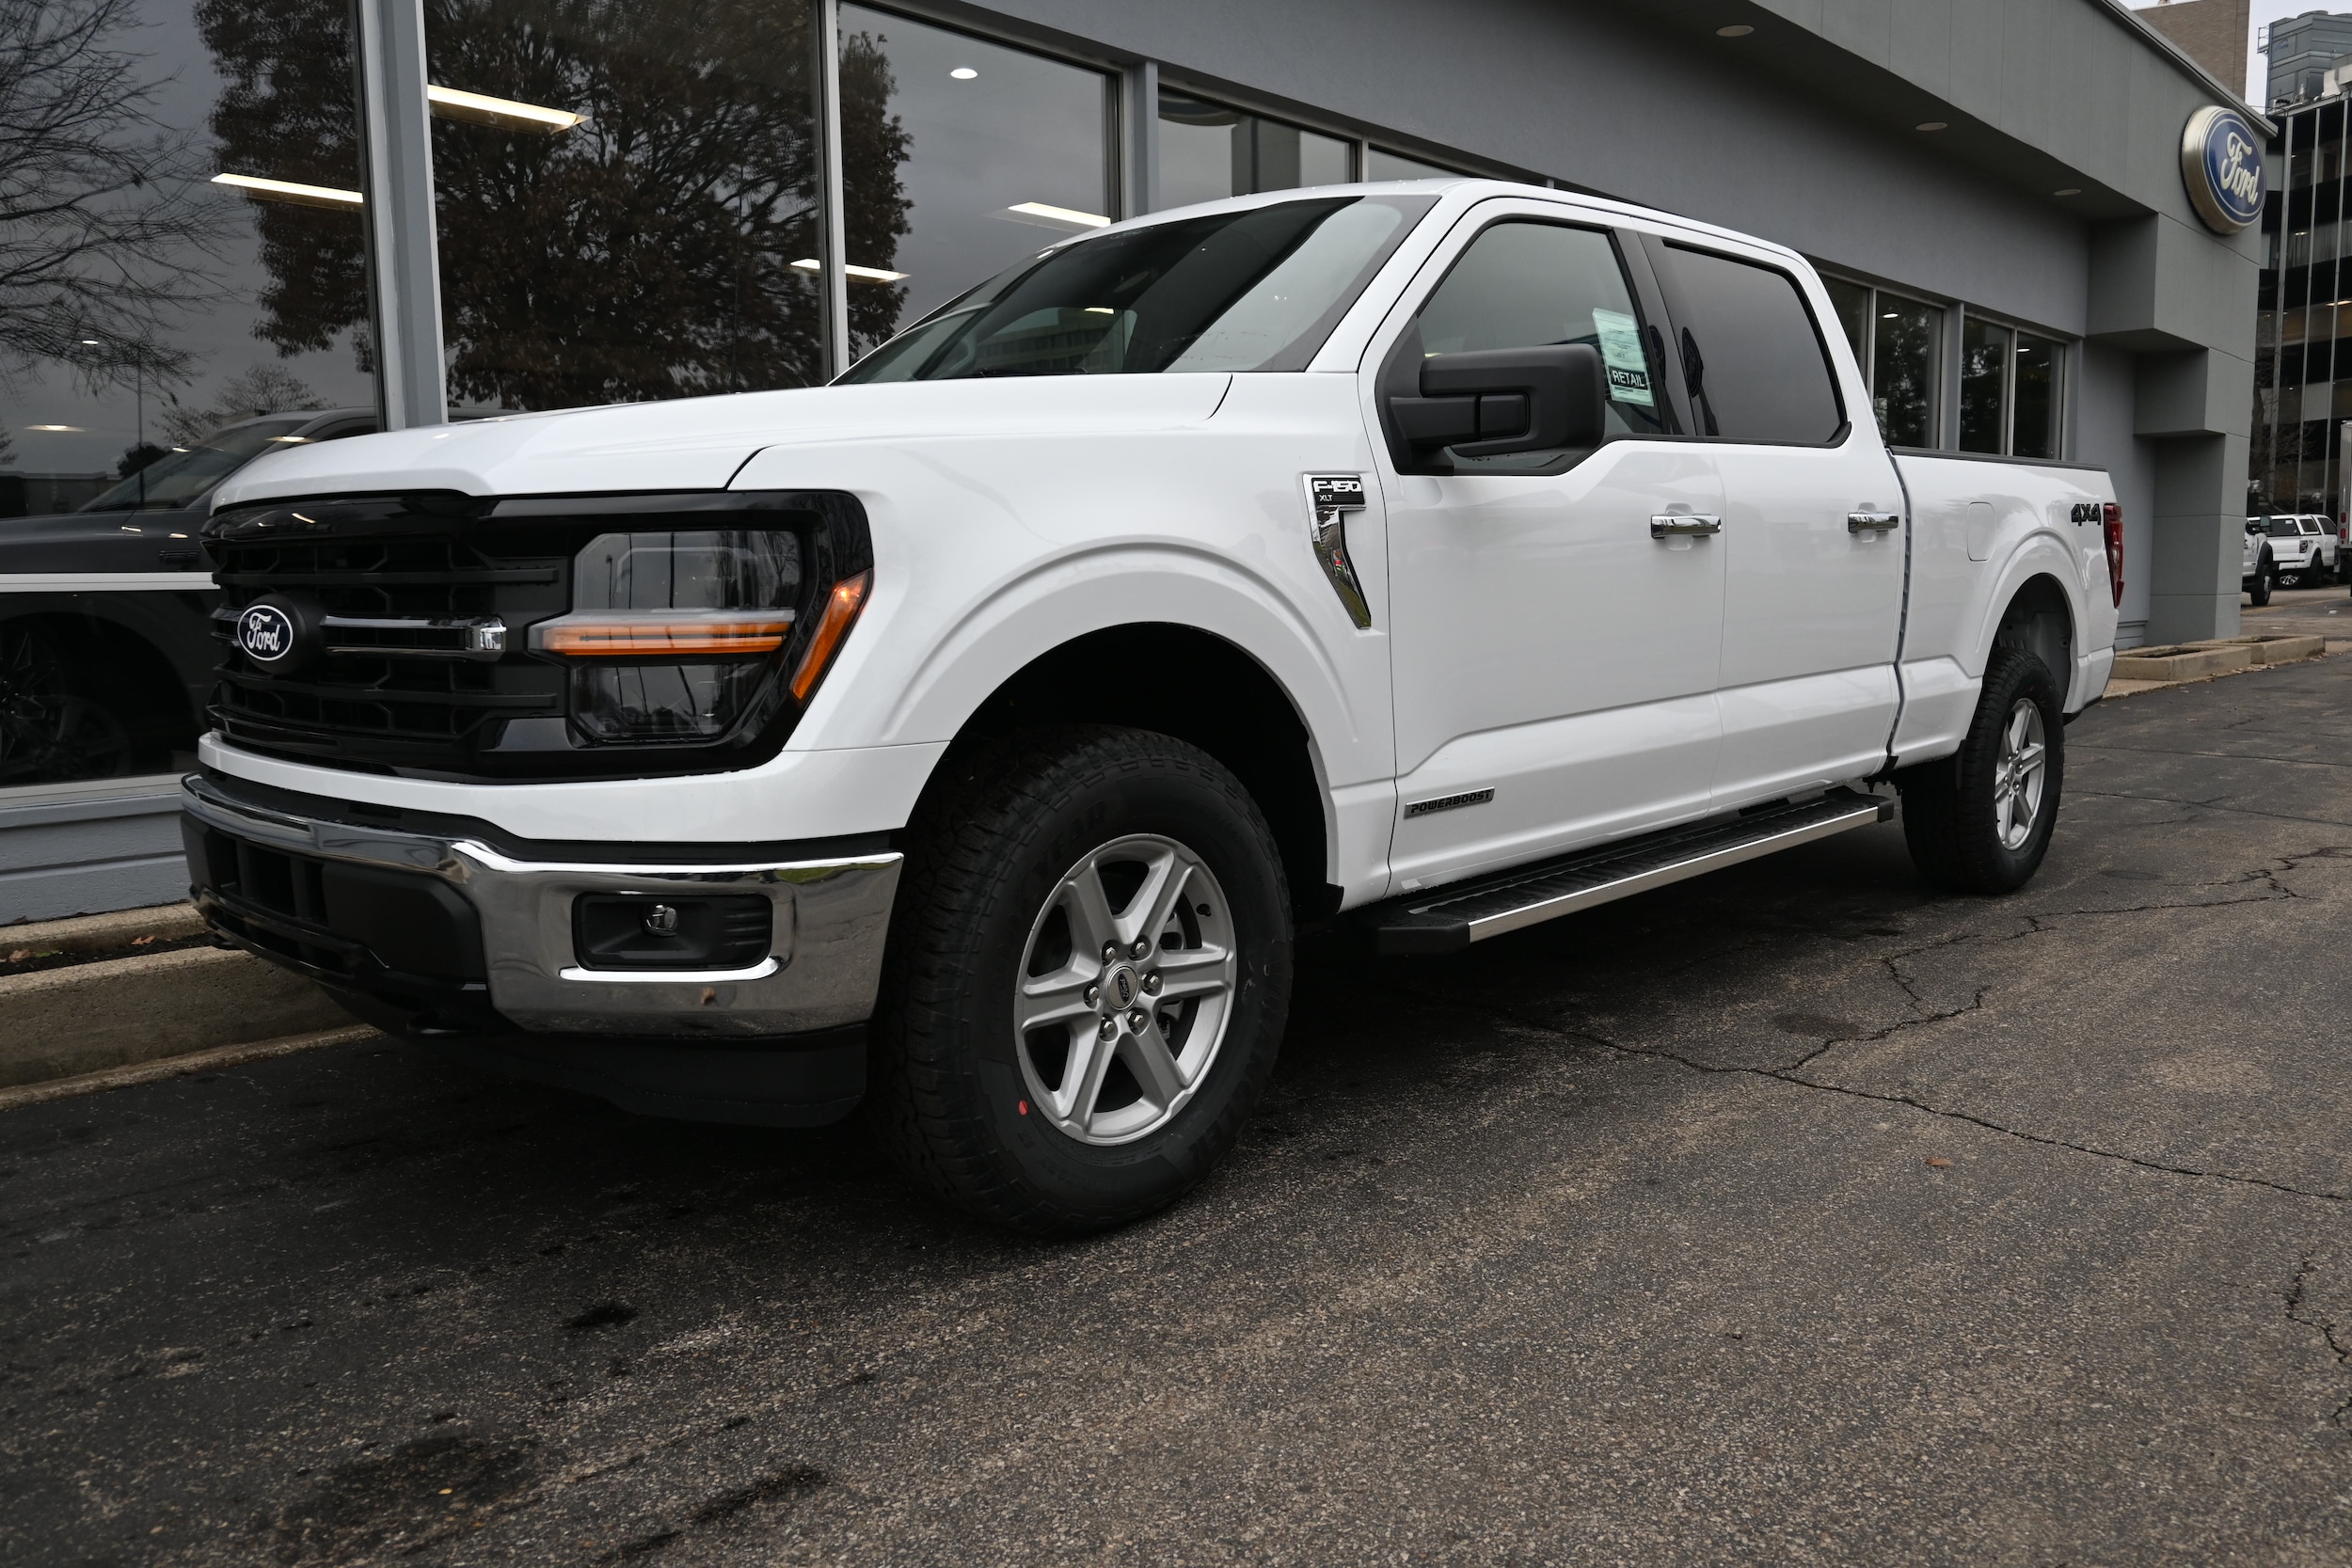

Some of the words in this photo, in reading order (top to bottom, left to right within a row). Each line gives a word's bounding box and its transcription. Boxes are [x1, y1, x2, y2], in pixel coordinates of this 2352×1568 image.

[2220, 132, 2260, 206] Ford
[1612, 370, 1645, 388] RETAIL
[1312, 480, 1362, 493] F-150
[246, 611, 281, 652] Ford
[1410, 790, 1491, 814] POWERBOOST
